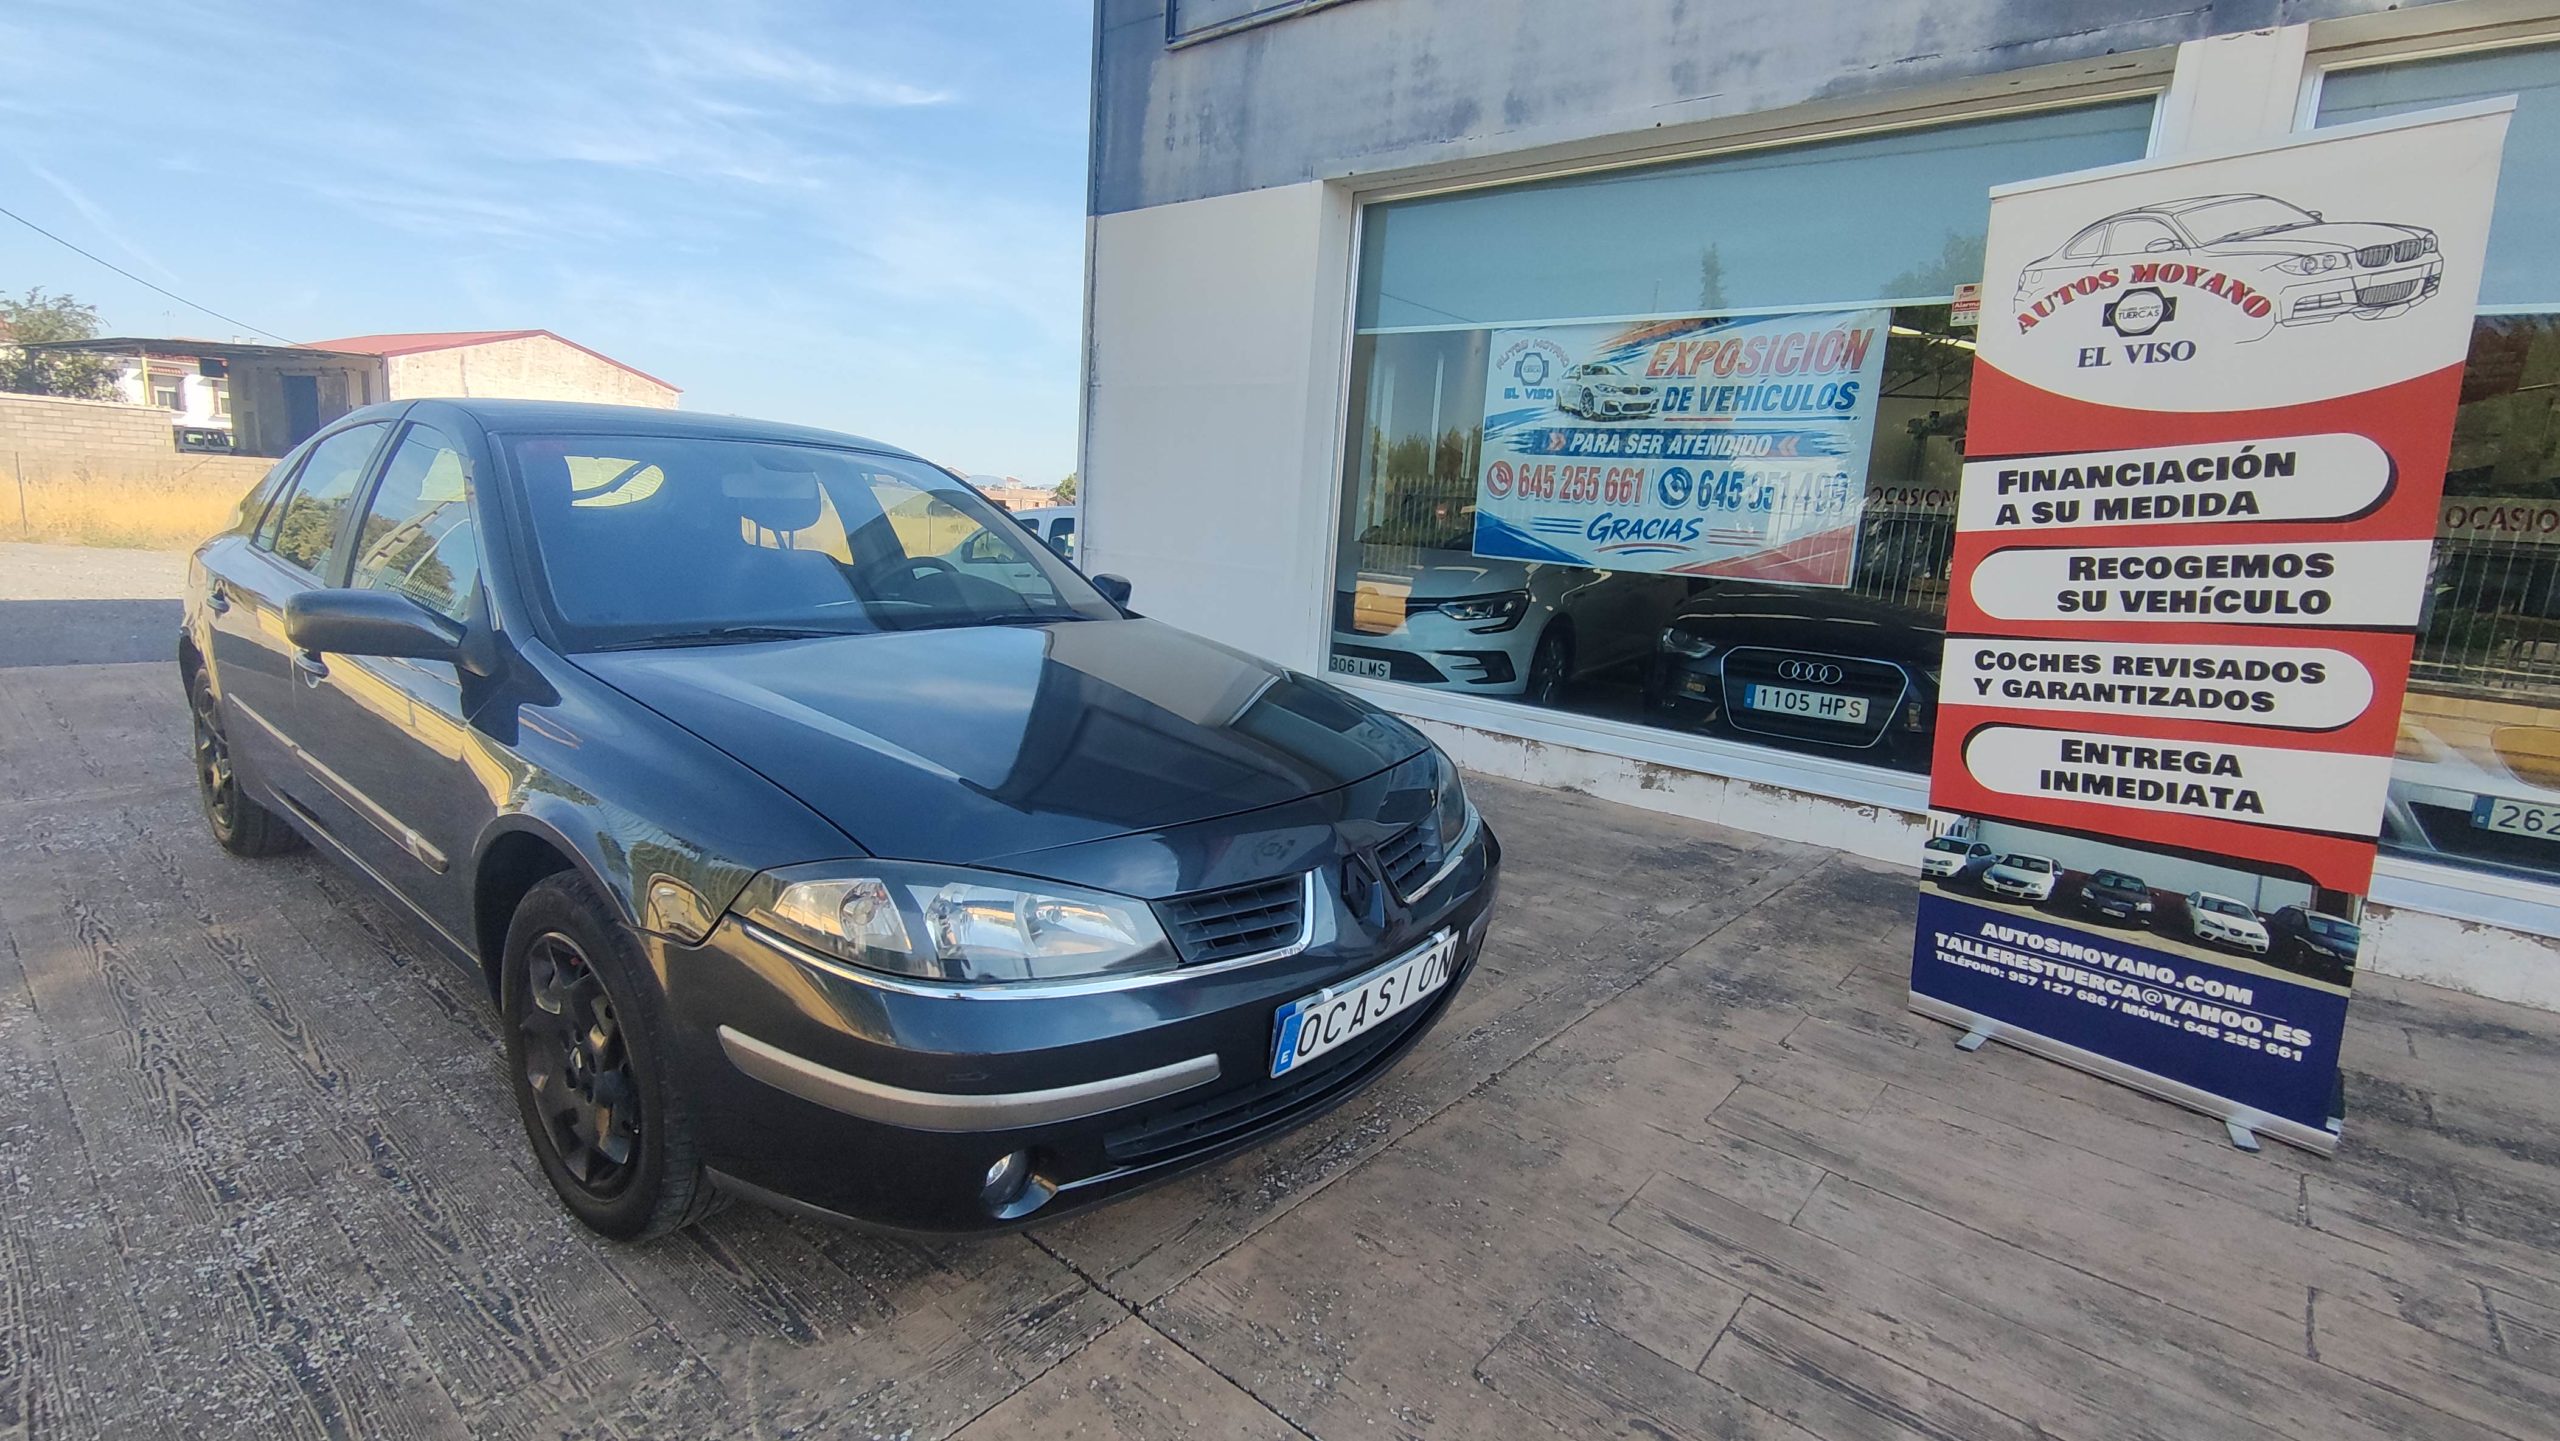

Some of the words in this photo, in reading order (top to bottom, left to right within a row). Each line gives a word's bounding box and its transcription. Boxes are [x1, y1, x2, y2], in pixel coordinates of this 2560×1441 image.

[2017, 268, 2119, 334] AUTOS
[2130, 263, 2272, 318] MOYANO
[2118, 310, 2160, 320] TUERCAS
[1646, 321, 1875, 377] EXPOSICIÓN
[2077, 347, 2111, 368] EL
[2125, 340, 2197, 364] VISO
[1662, 386, 1695, 412] DE
[1700, 378, 1860, 412] VEHÍCULOS
[1569, 434, 1620, 453] PARA
[1625, 434, 1664, 455] SER
[1667, 434, 1774, 457] ATENDIDO
[1517, 463, 1556, 500] 645
[1560, 465, 1600, 502] 255
[1606, 468, 1645, 505] 661
[1998, 445, 2296, 495] FINANCIACIÓN
[1698, 469, 1745, 509] 645
[1995, 504, 2021, 525] A
[2032, 500, 2080, 524] SU
[2094, 490, 2260, 521] MEDIDA
[1586, 512, 1704, 542] GRACIAS
[2069, 552, 2335, 581] RECOGEMOS
[2057, 590, 2107, 613] SU
[2120, 586, 2331, 615] VEHÍCULO
[1360, 660, 1386, 677] LMS
[1975, 650, 2101, 674] COCHES
[2113, 656, 2326, 684] REVISADOS
[1761, 688, 1809, 711] 1105
[1818, 696, 1862, 718] HPS
[1974, 678, 1993, 696] Y
[2002, 679, 2275, 713] GARANTIZADOS
[2061, 739, 2243, 778] ENTREGA
[2040, 769, 2264, 814] INMEDIATA
[2498, 805, 2560, 835] 262
[1981, 922, 2253, 1005] AUTOSMOYANO.COM
[1297, 940, 1456, 1057] OCASION
[1935, 932, 2312, 1046] TALLERESTUERCA@YAHOO.ES
[1935, 950, 2005, 978] TELÉFONO:
[2008, 971, 2038, 986] 957
[2043, 980, 2073, 996] 127
[2076, 989, 2107, 1007] 686
[2184, 1021, 2219, 1039] 645
[2224, 1031, 2261, 1050] 255
[2265, 1043, 2302, 1062] 661
[1281, 1050, 1291, 1064] E
